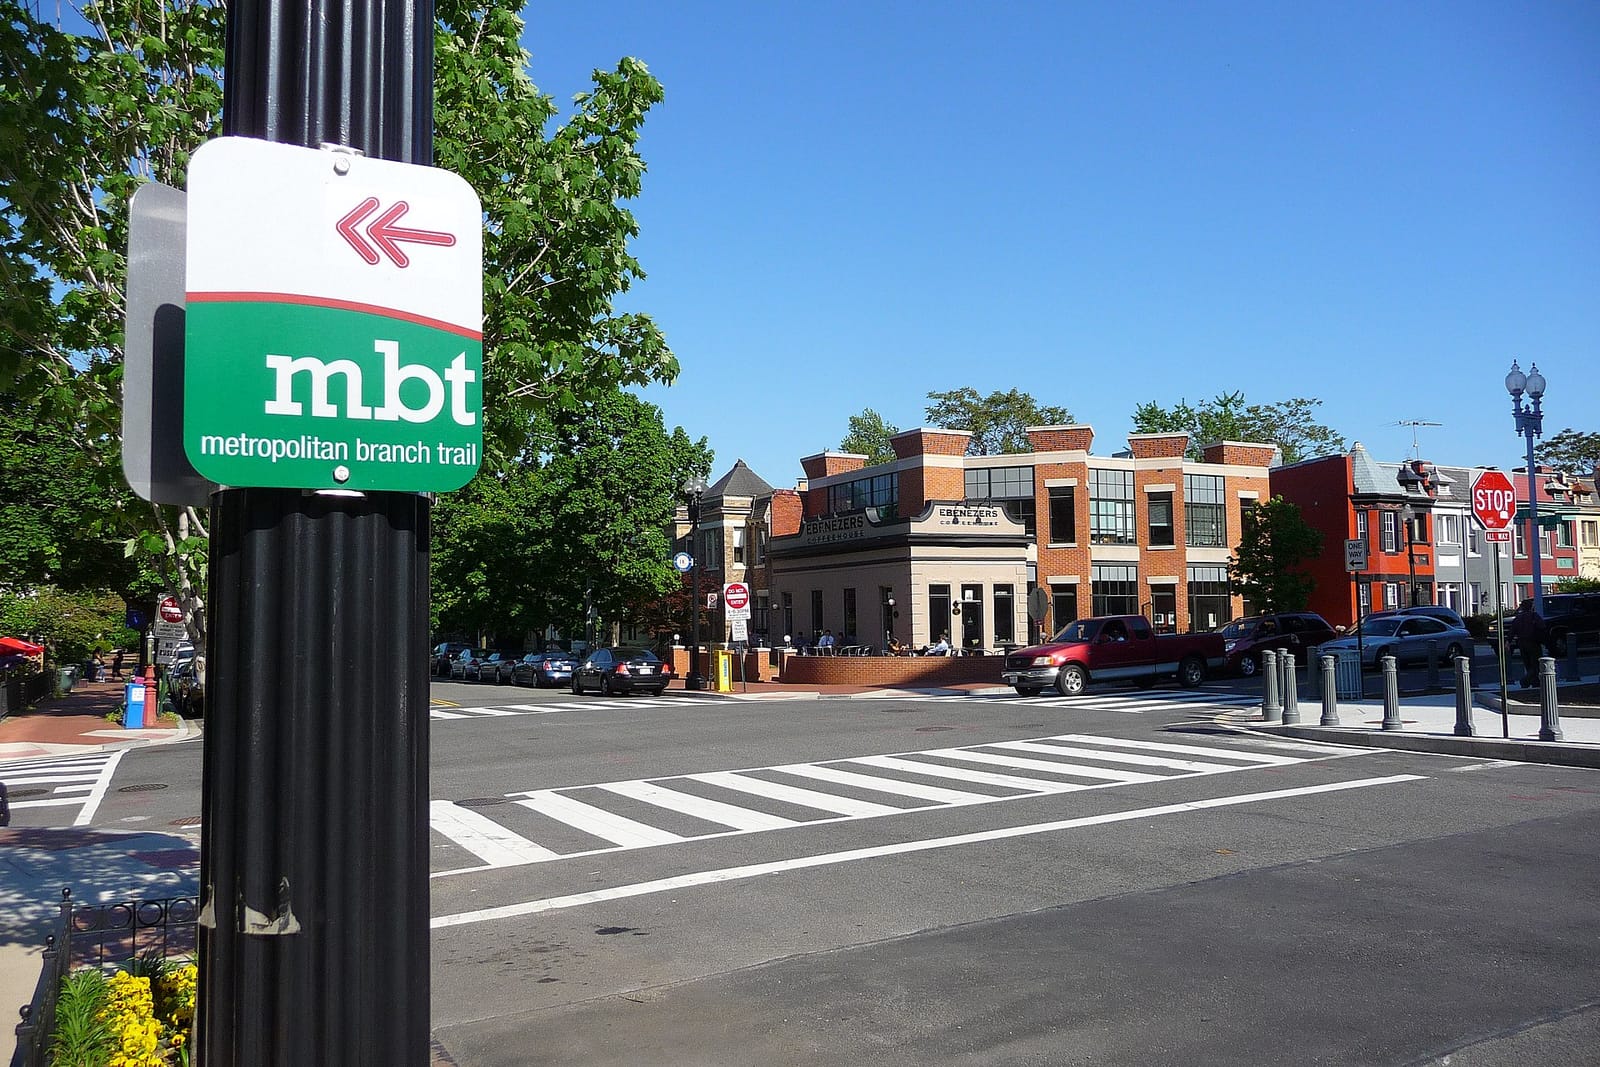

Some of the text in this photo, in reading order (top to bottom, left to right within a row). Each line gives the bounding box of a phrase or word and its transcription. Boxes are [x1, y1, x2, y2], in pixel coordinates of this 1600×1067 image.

[264, 339, 476, 426] mbt
[201, 433, 476, 466] metropolitan branch trail
[1476, 489, 1513, 511] STOP
[939, 508, 998, 518] EBENEZERS
[806, 515, 864, 535] EBENEZERS
[1498, 532, 1508, 540] WAY
[1348, 542, 1362, 550] ONE
[1348, 550, 1363, 558] WAY
